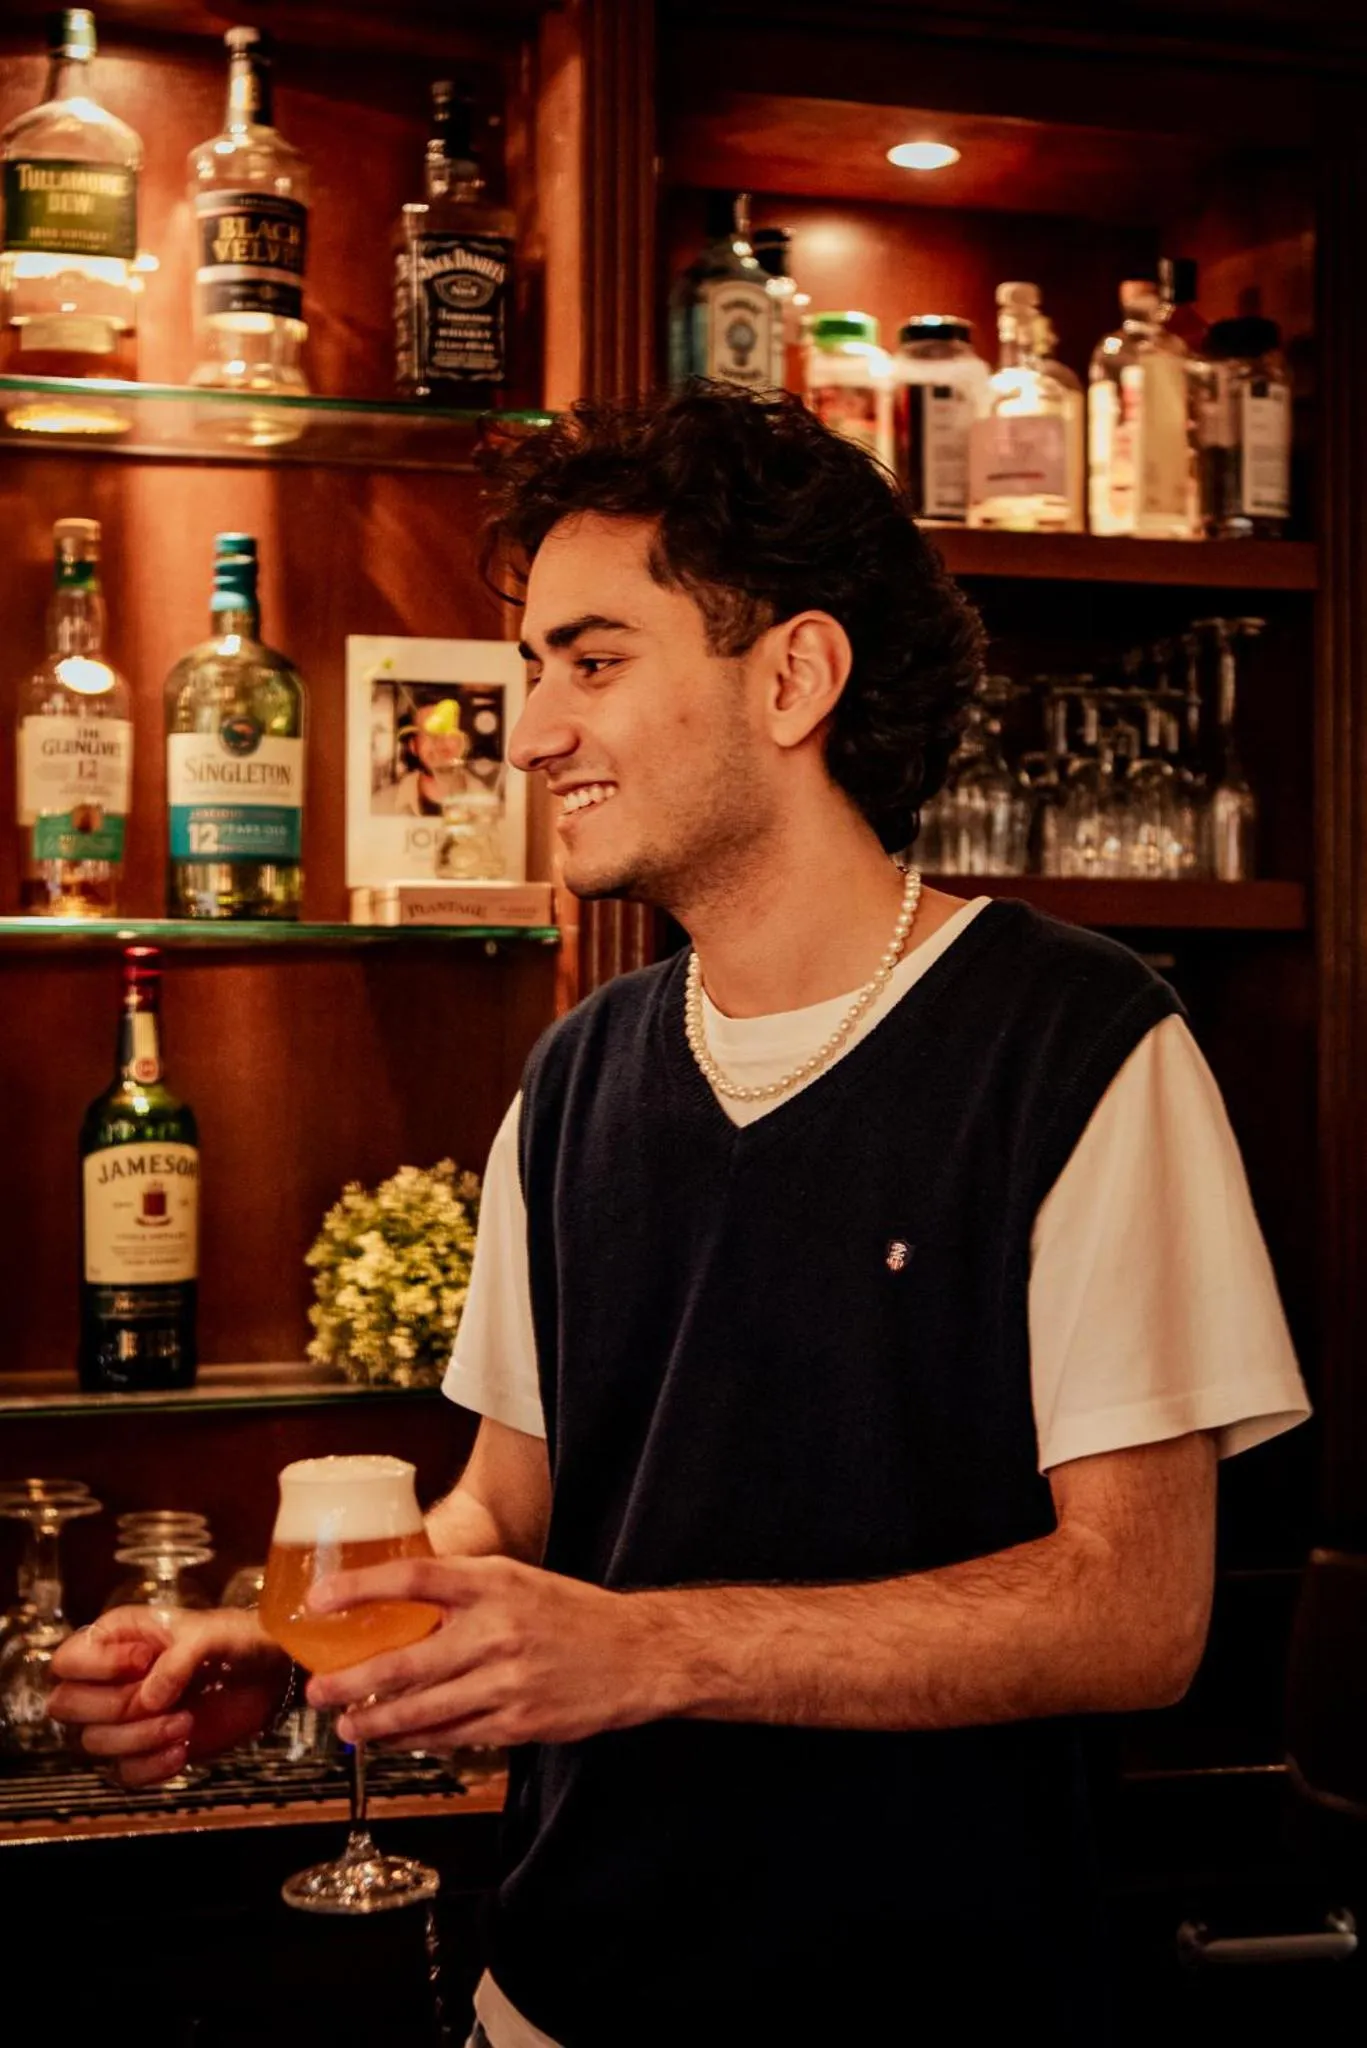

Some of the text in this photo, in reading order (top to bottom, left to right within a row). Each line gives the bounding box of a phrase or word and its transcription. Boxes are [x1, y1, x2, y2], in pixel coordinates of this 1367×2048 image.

[219, 216, 299, 245] BLACK
[184, 757, 292, 786] SINGLETON
[188, 821, 219, 854] 12
